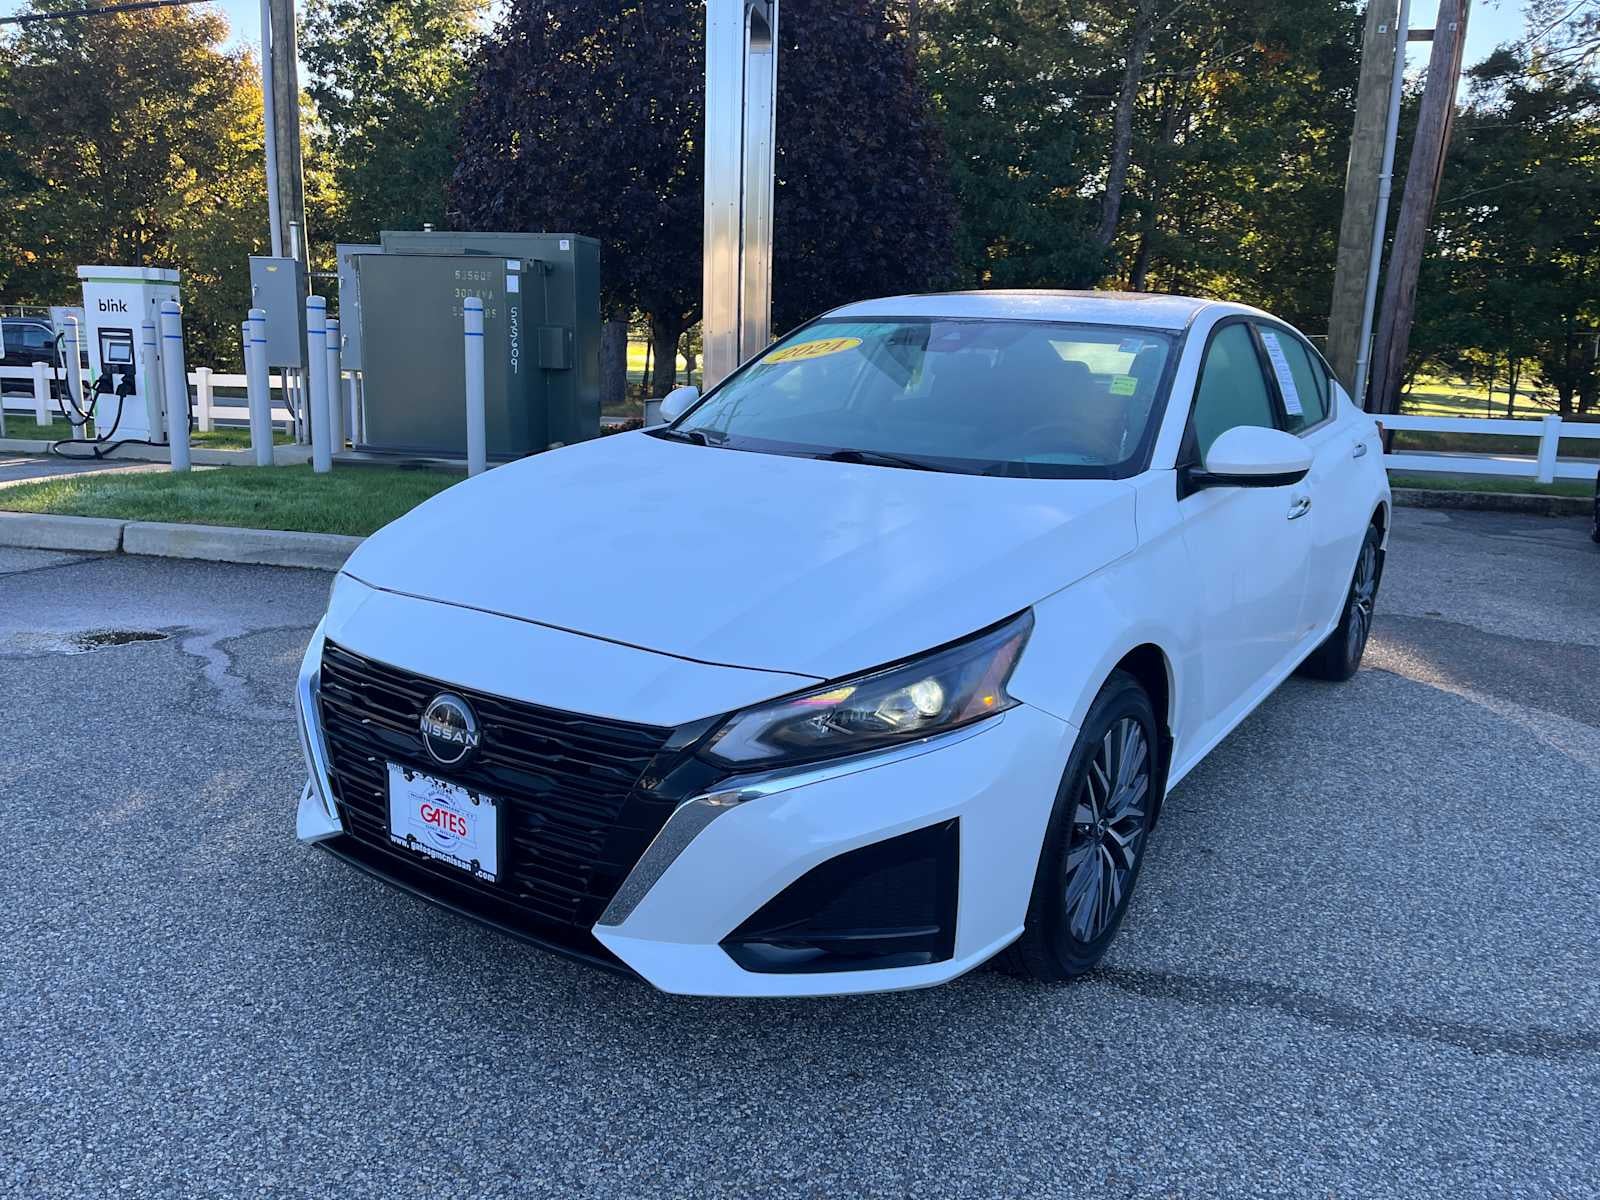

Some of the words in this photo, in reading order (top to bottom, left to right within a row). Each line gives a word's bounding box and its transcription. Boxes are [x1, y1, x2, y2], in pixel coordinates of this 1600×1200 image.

[98, 299, 128, 313] blink
[774, 339, 849, 362] 2024
[420, 715, 479, 746] NISSAN
[420, 804, 468, 837] GATES
